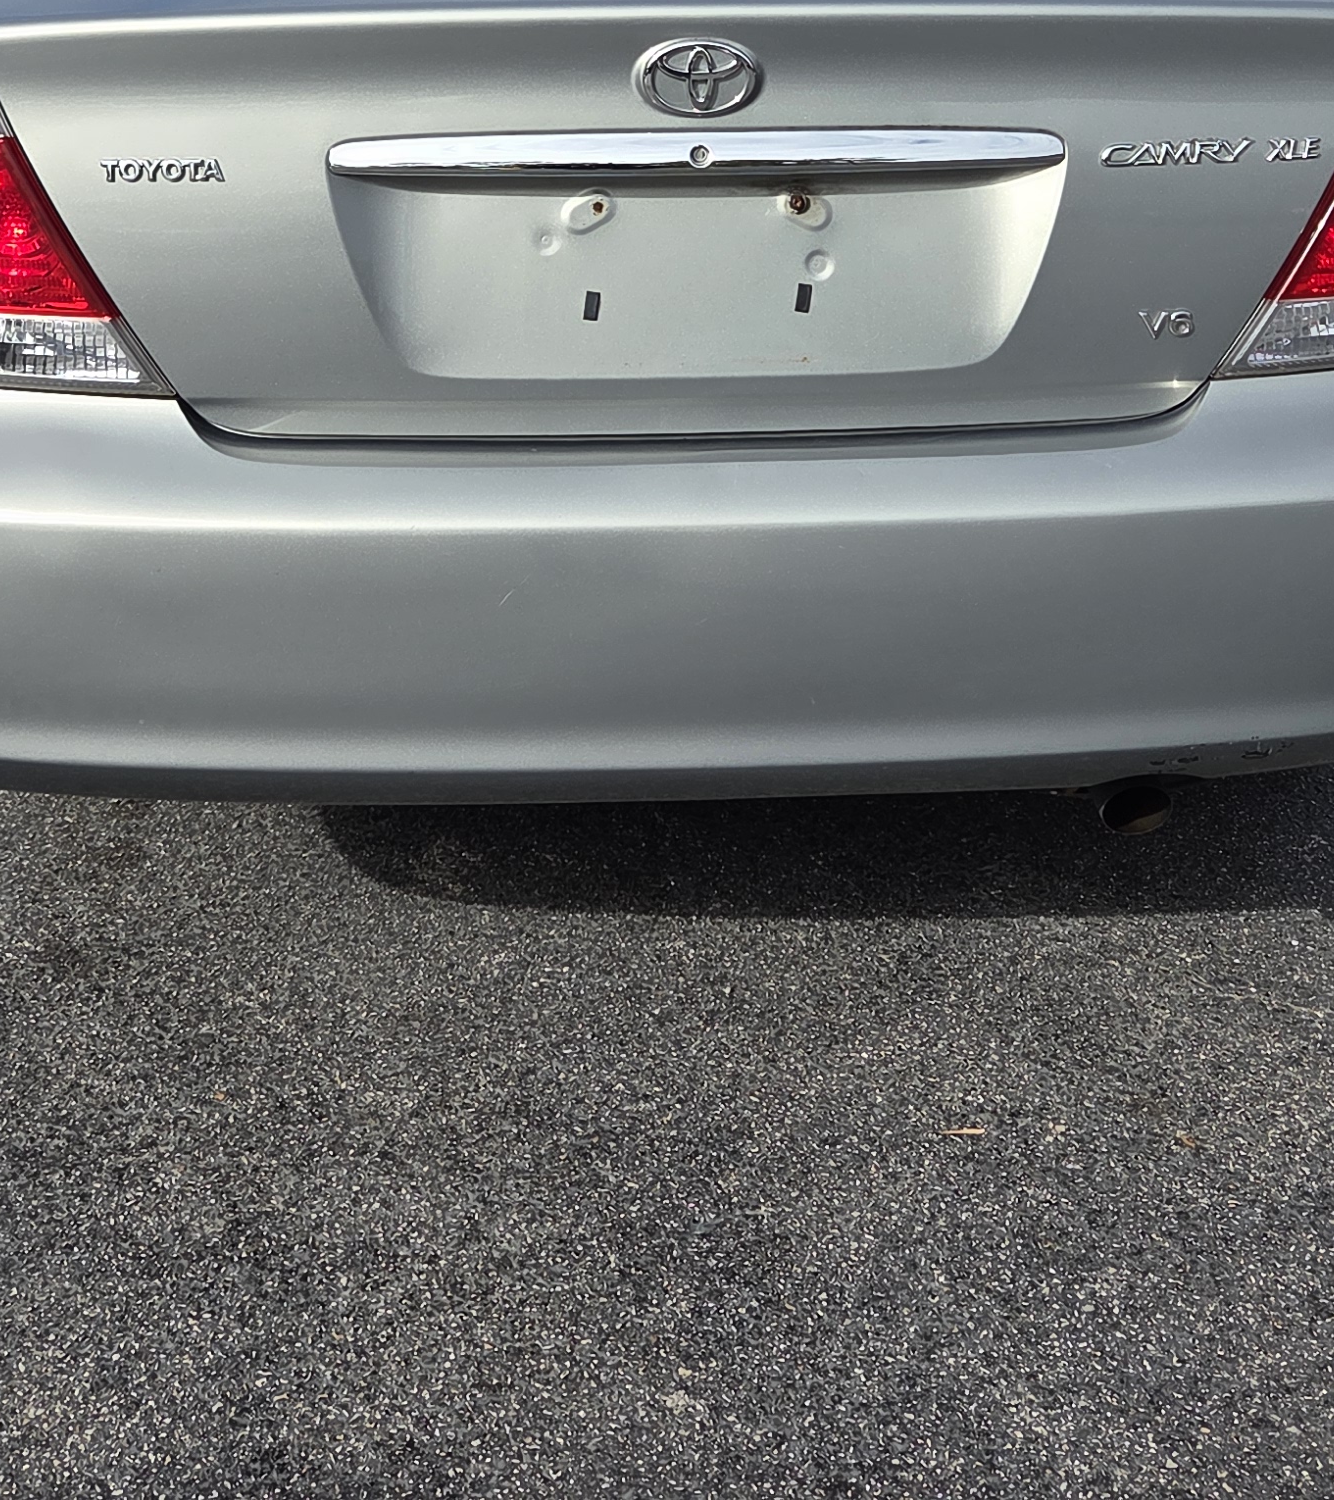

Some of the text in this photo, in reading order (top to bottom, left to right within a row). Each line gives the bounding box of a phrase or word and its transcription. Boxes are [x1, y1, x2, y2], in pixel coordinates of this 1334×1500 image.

[1099, 137, 1322, 168] CAMRY XLE
[99, 158, 226, 183] TOYOTA
[1138, 308, 1195, 340] V6
